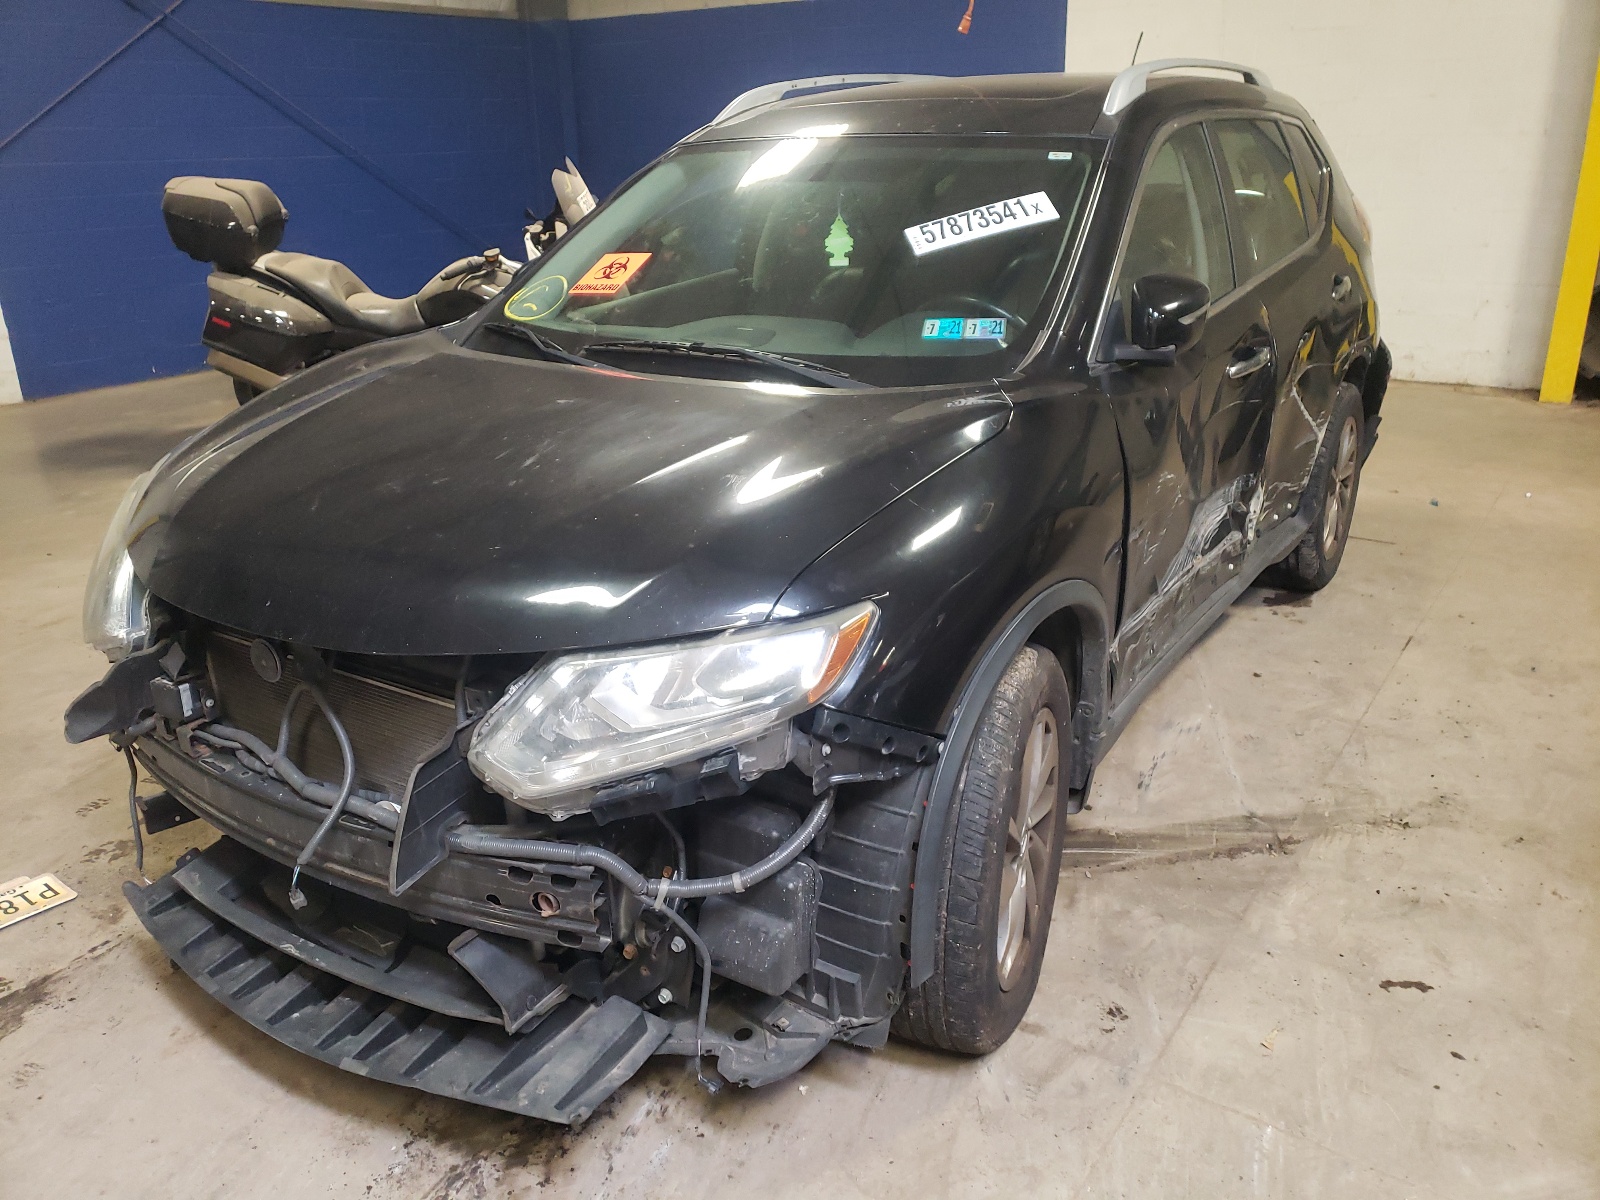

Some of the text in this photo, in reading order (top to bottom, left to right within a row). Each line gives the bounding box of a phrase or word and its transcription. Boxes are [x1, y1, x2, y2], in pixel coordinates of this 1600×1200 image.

[919, 198, 1031, 244] 57873541
[573, 283, 620, 291] BIOHAZARD
[949, 320, 961, 334] 21
[991, 320, 1003, 335] 21
